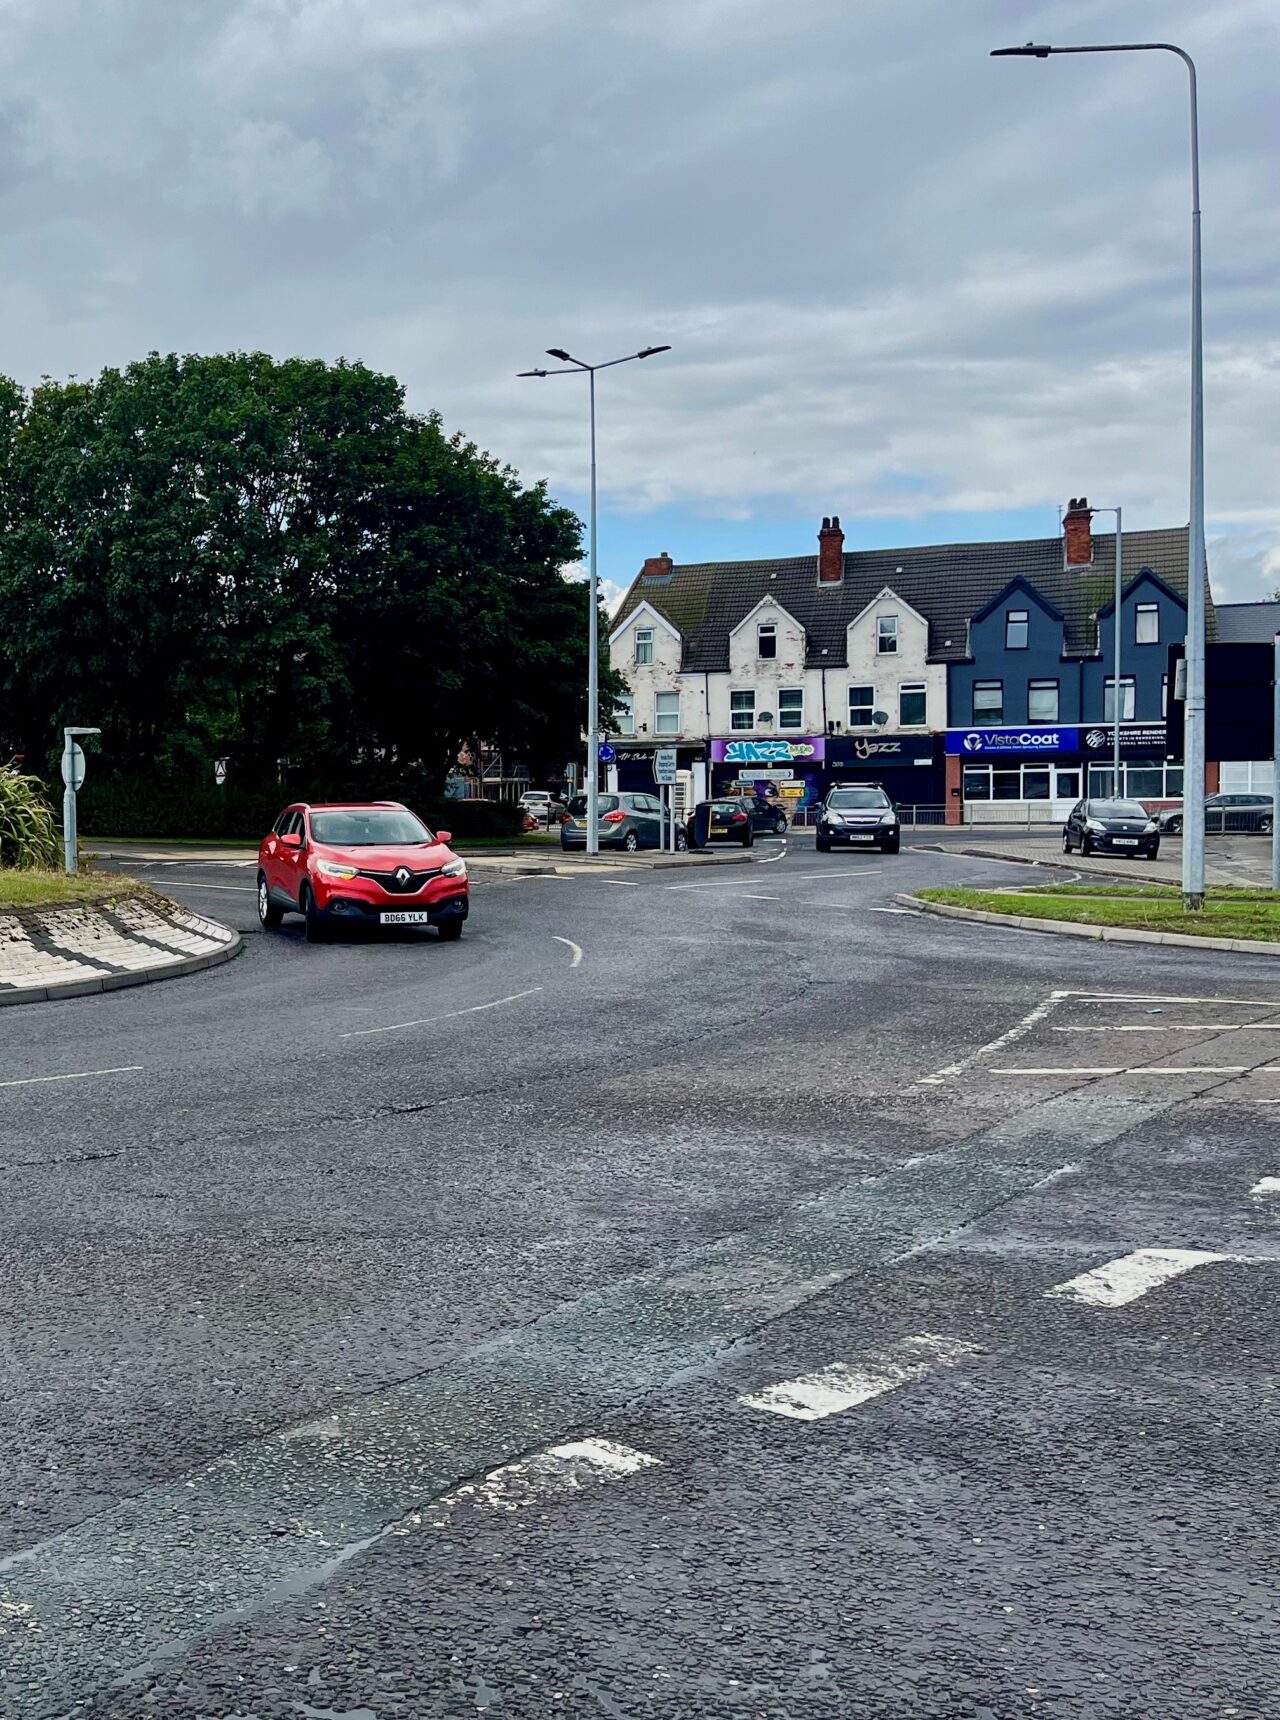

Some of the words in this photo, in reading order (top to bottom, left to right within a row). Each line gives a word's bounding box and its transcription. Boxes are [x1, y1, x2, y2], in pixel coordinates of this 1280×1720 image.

[985, 733, 1059, 746] VistaCoat
[725, 741, 793, 761] YAZZ
[384, 914, 406, 922] BD66
[408, 913, 424, 922] YLK
